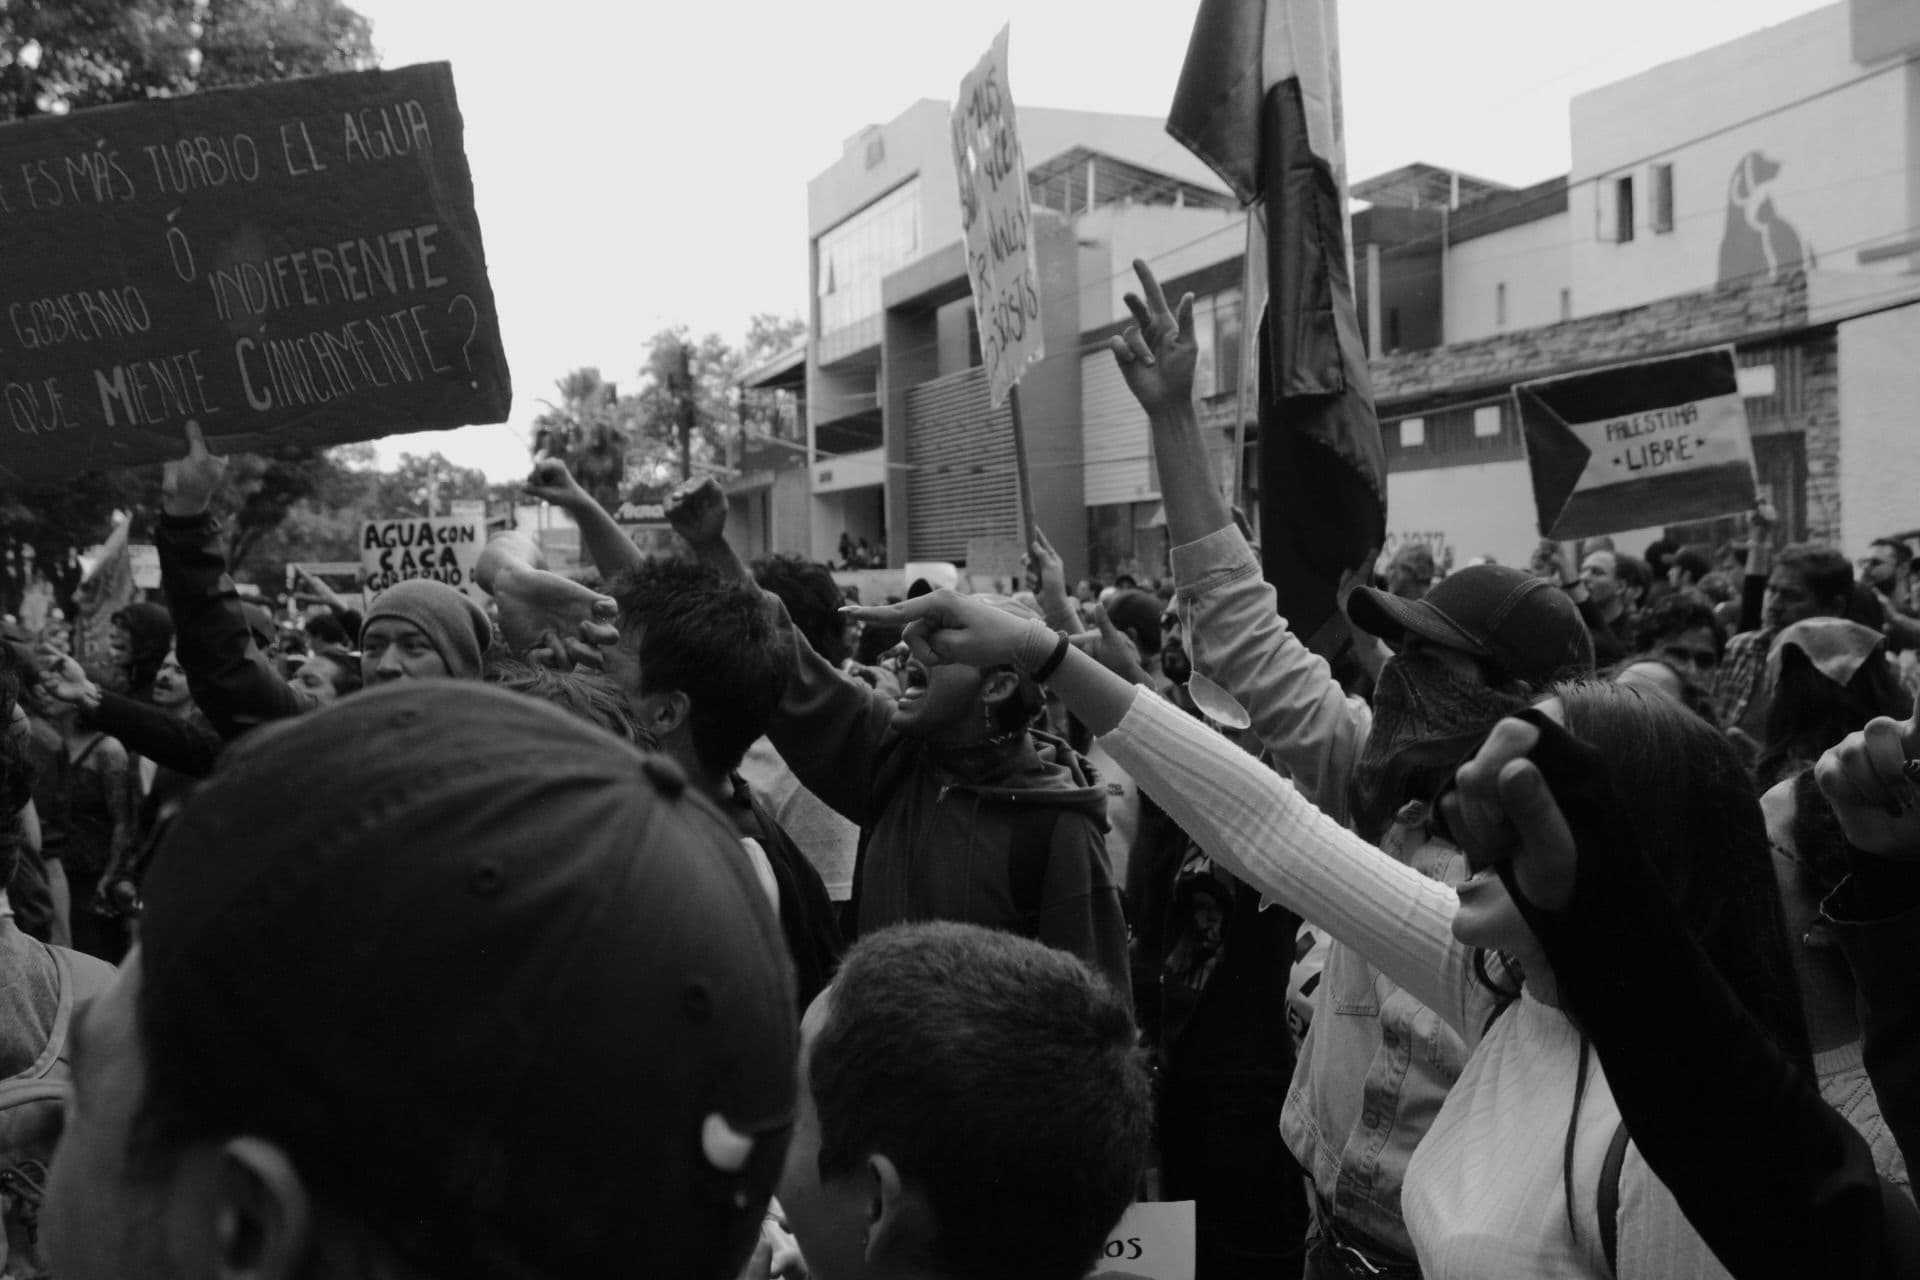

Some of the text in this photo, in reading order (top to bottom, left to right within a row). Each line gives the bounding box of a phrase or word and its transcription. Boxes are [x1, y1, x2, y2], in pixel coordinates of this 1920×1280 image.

[65, 138, 136, 204] MÁS
[144, 133, 260, 194] TURBIO
[280, 120, 328, 176] EL
[344, 99, 433, 163] AGUA
[9, 223, 448, 348] GOBIERNO INDIFERENTE
[5, 376, 80, 435] QUE
[94, 349, 219, 427] MIENTE
[1605, 403, 1698, 442] PALESTINA
[1626, 435, 1694, 471] LIBRE
[364, 522, 475, 550] AGUA CON
[378, 545, 459, 572] CACA
